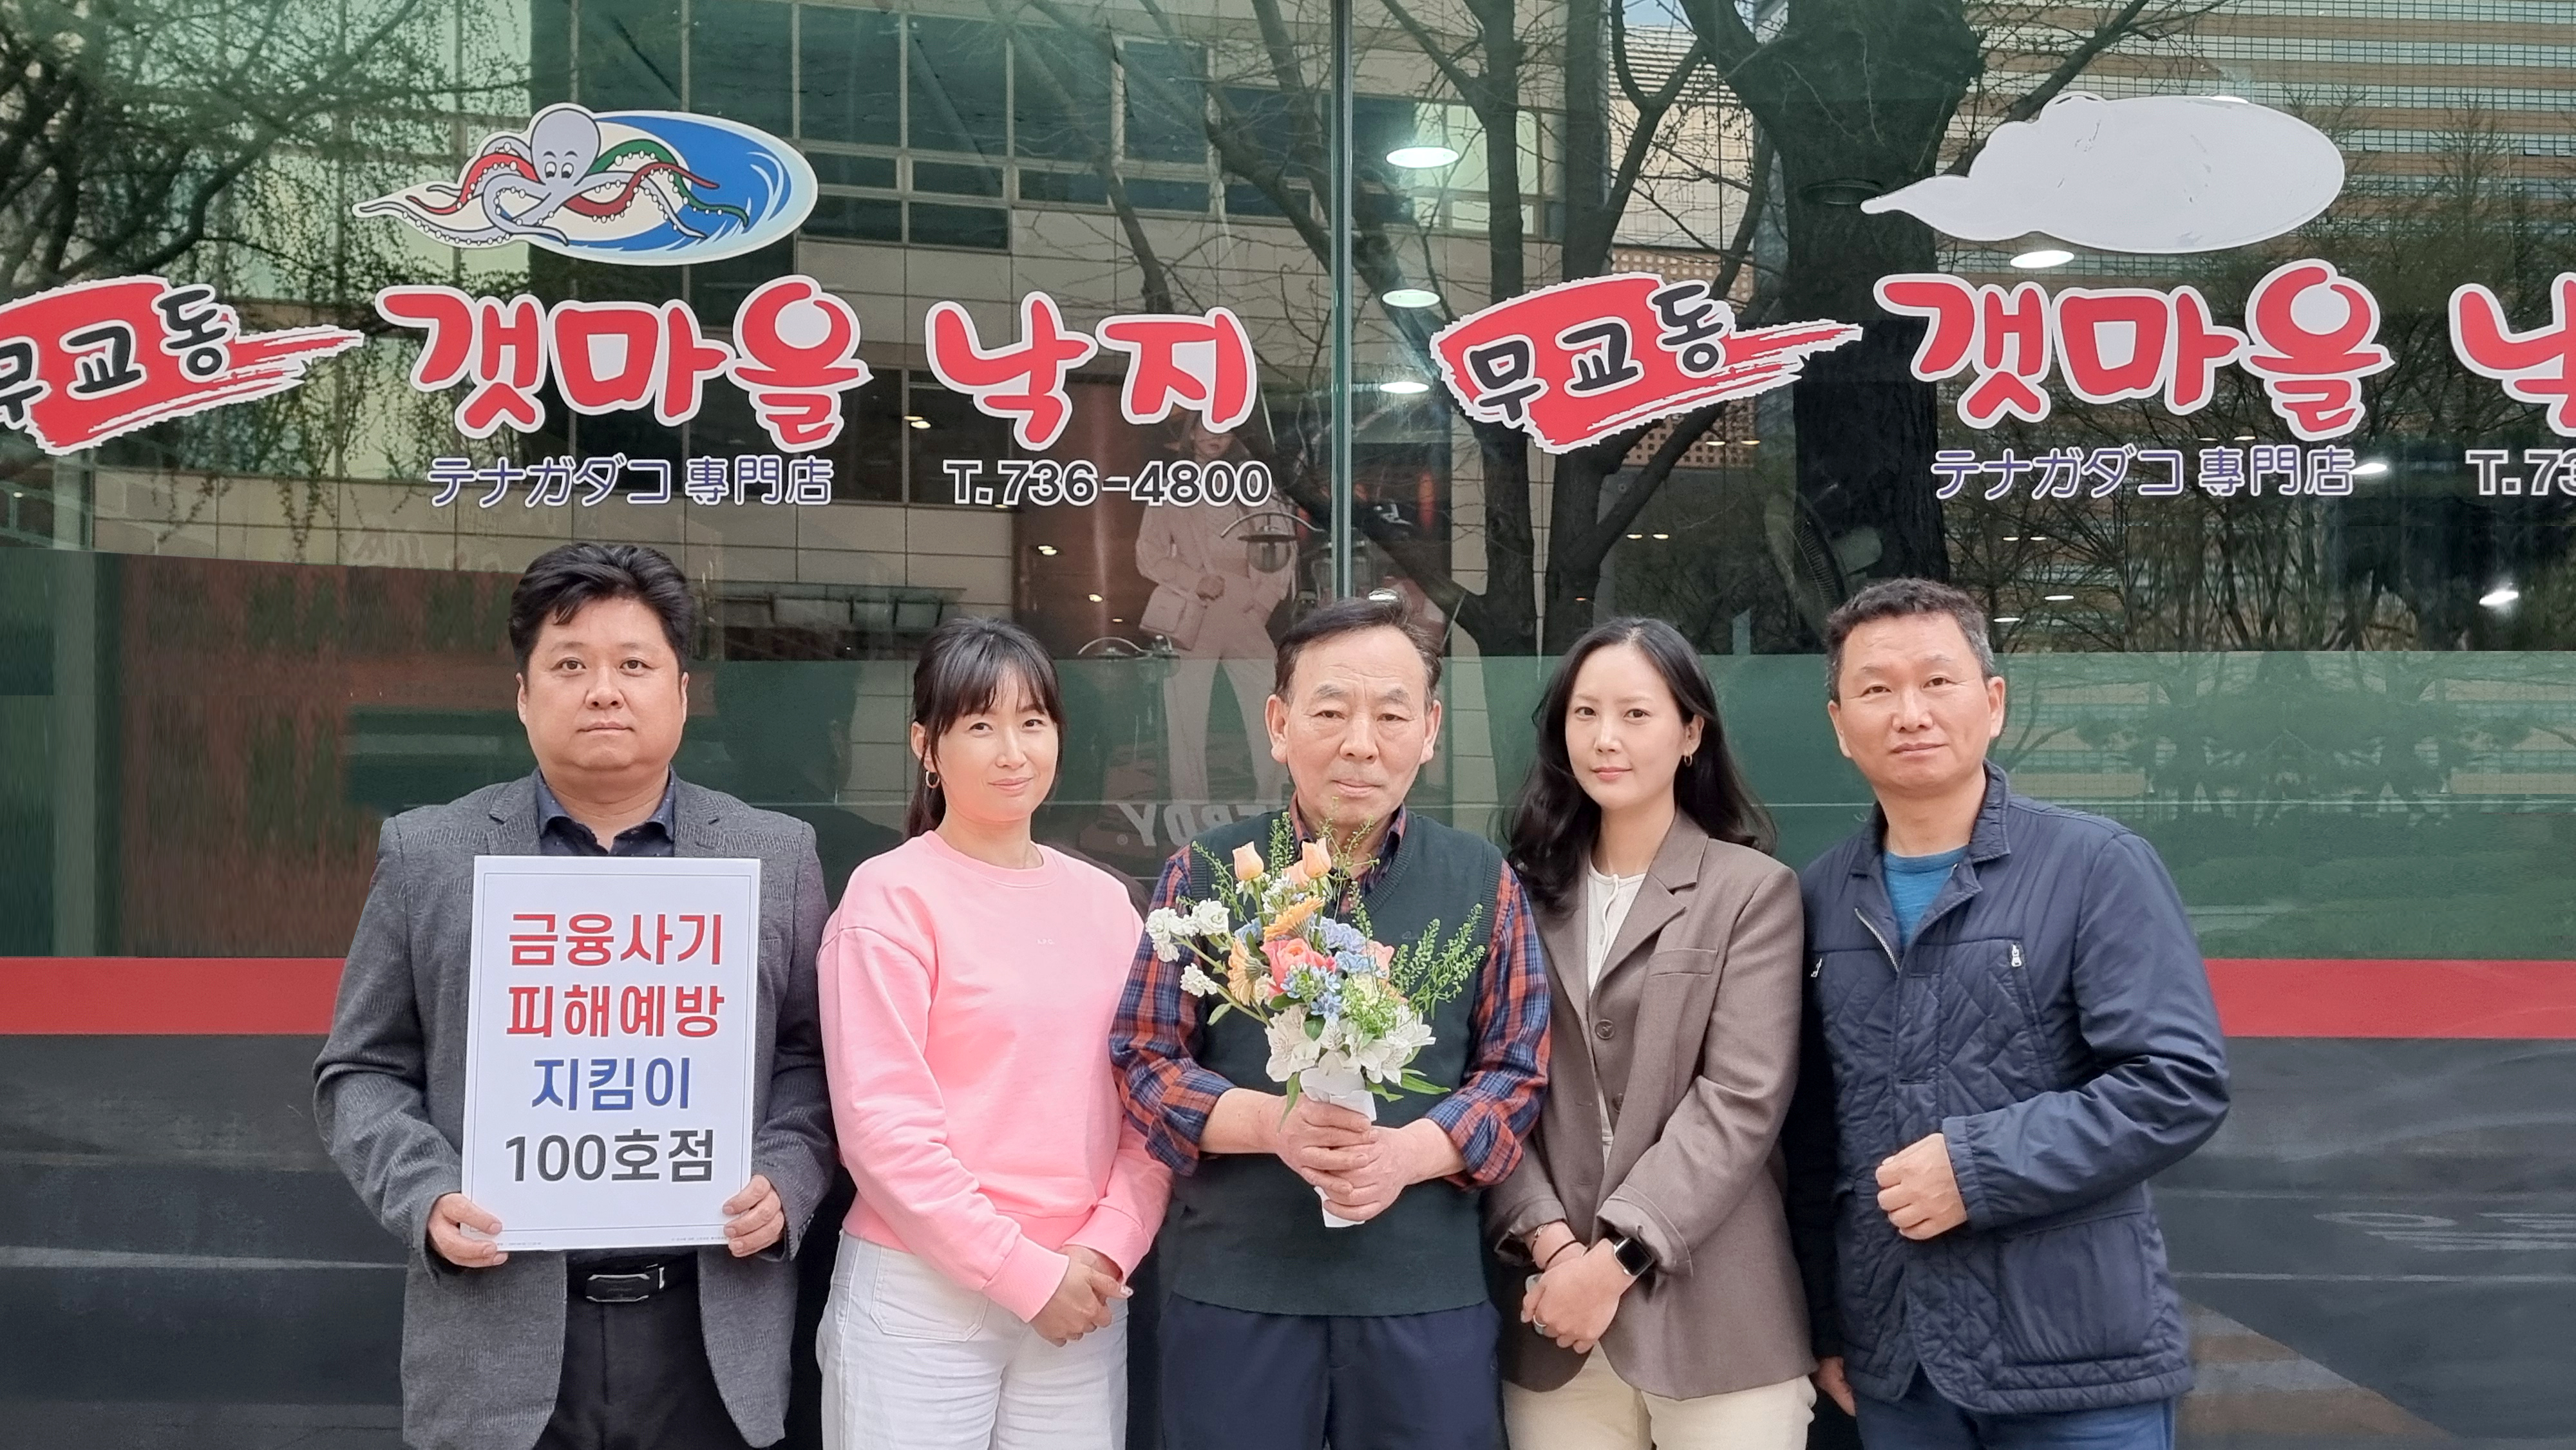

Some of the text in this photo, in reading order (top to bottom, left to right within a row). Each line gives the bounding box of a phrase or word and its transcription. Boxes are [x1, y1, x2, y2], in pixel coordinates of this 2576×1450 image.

[375, 274, 874, 453] 갯마을
[925, 291, 1257, 451] 낙지
[1468, 283, 1726, 422] 무교동
[1873, 258, 2395, 441] 갯마을
[509, 913, 721, 966] 금융사기
[506, 984, 725, 1038] 피해예방
[531, 1057, 690, 1111] 지킴이
[505, 1128, 714, 1182] 100호점
